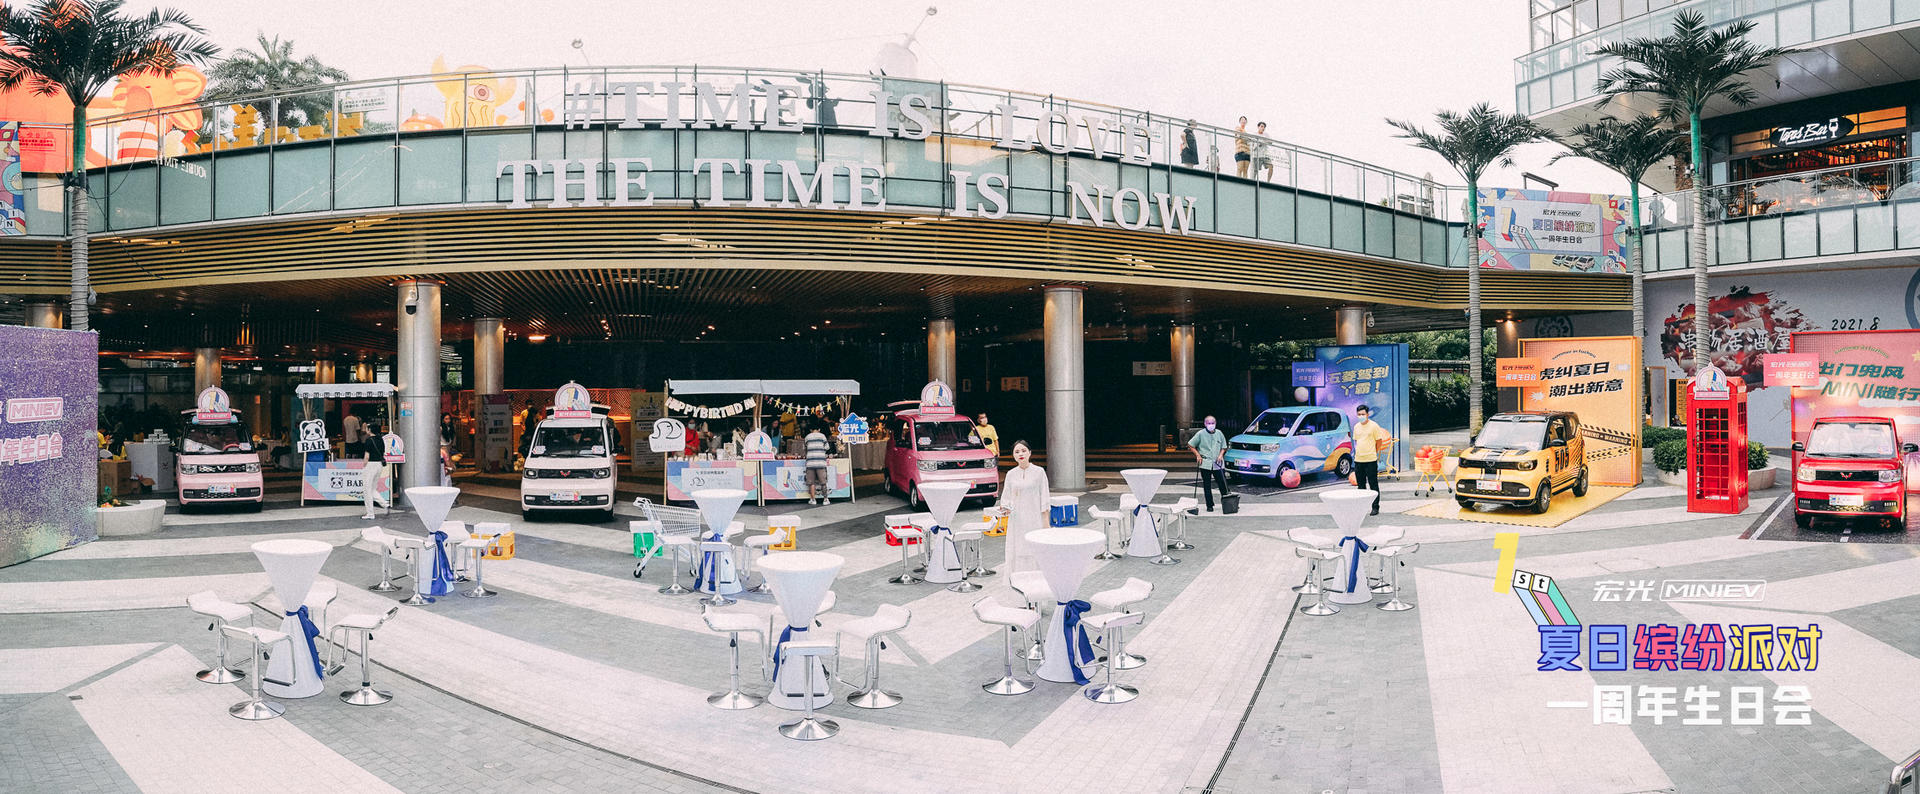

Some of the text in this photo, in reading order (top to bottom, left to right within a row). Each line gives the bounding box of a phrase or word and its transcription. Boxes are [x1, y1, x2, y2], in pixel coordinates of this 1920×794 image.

[565, 81, 1152, 166] #TIME IS LOVE
[496, 157, 1197, 237] THE TIME IS NOW
[1831, 317, 1881, 331] 2021.8
[1540, 361, 1610, 381] 虎纠夏日
[1549, 379, 1624, 398] 潮出新意
[10, 401, 61, 419] MINIEV
[0, 433, 63, 466] 年生日会
[301, 440, 326, 452] BAR
[1554, 447, 1570, 473] 505
